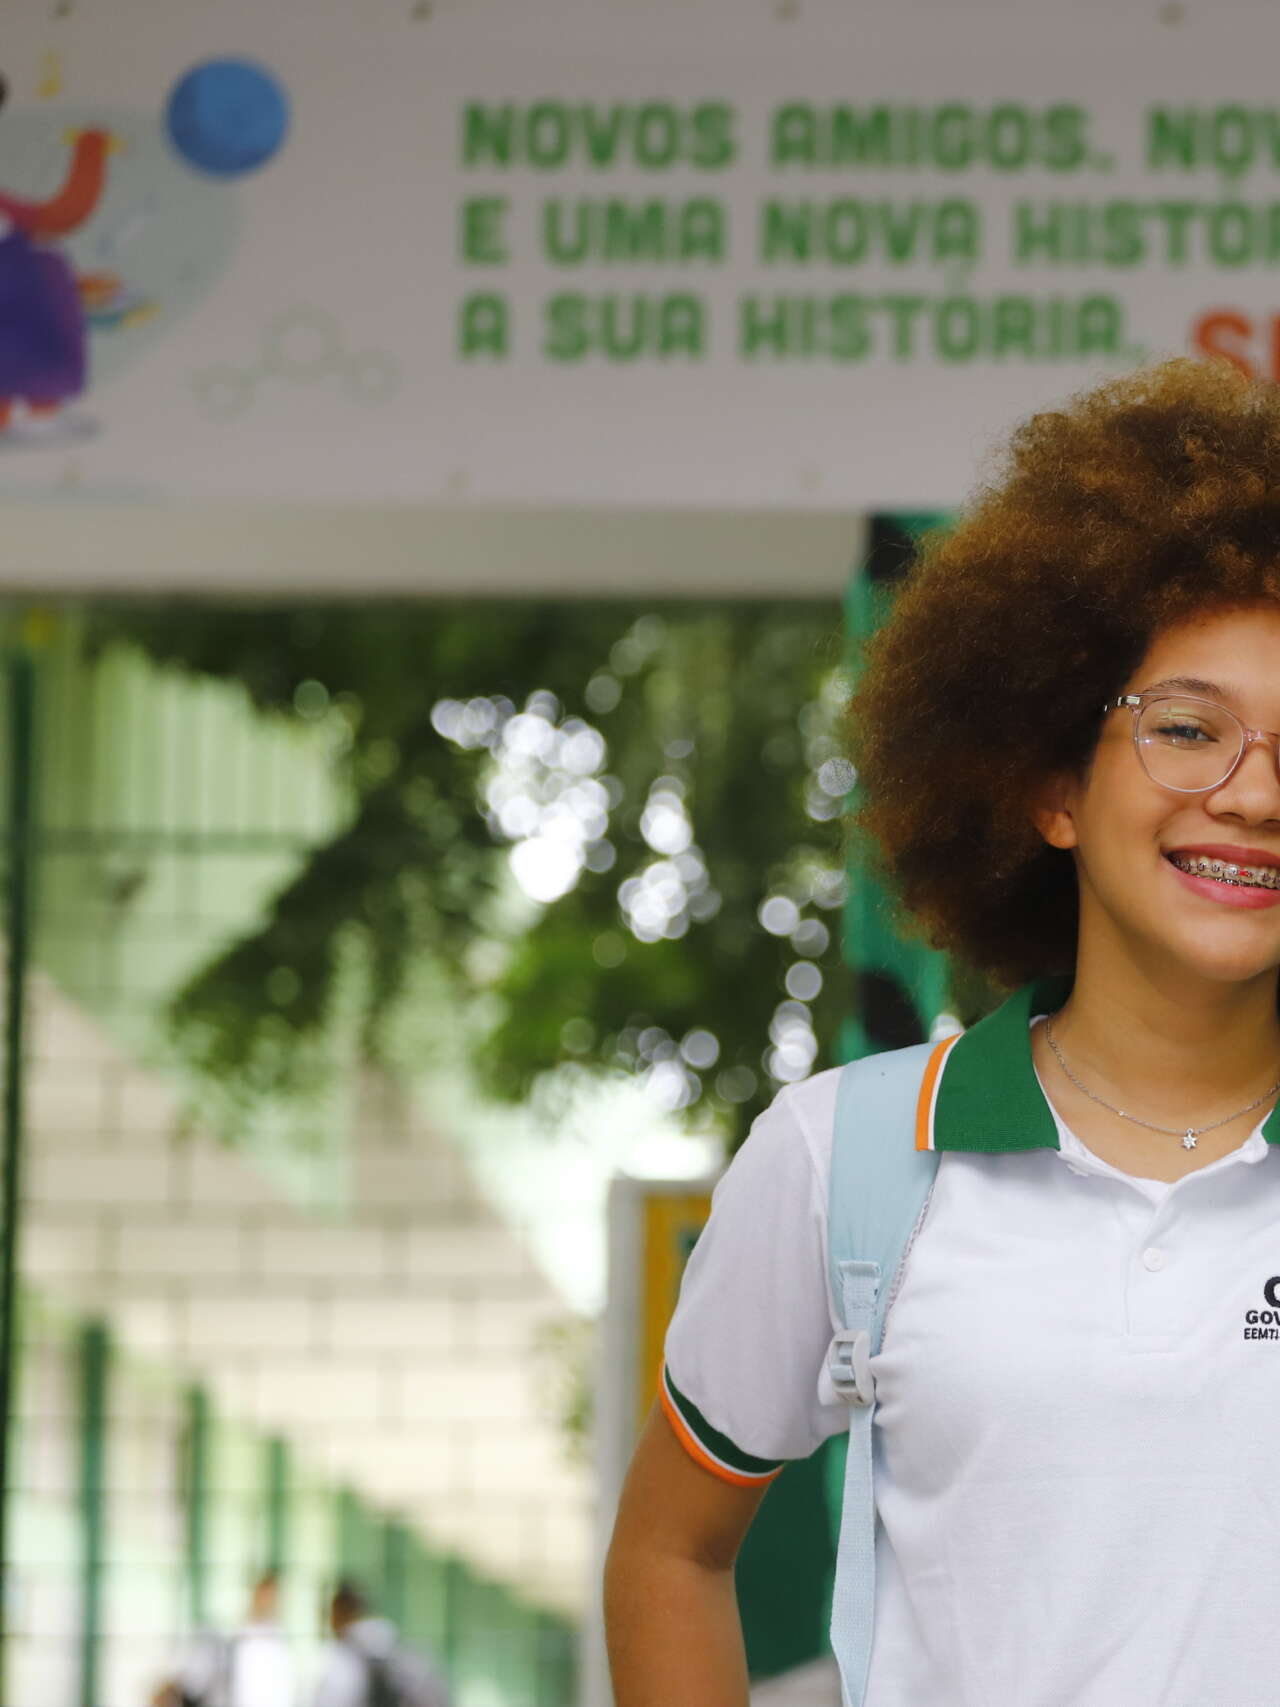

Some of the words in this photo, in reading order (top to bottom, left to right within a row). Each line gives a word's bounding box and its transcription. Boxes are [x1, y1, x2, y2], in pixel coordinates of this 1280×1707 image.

[462, 104, 736, 169] NOVOS
[770, 105, 1112, 172] AMIGOS.
[462, 200, 503, 264] E
[543, 200, 726, 264] UMA
[761, 202, 981, 264] NOVA
[461, 296, 510, 358] A
[546, 297, 705, 360] SUA
